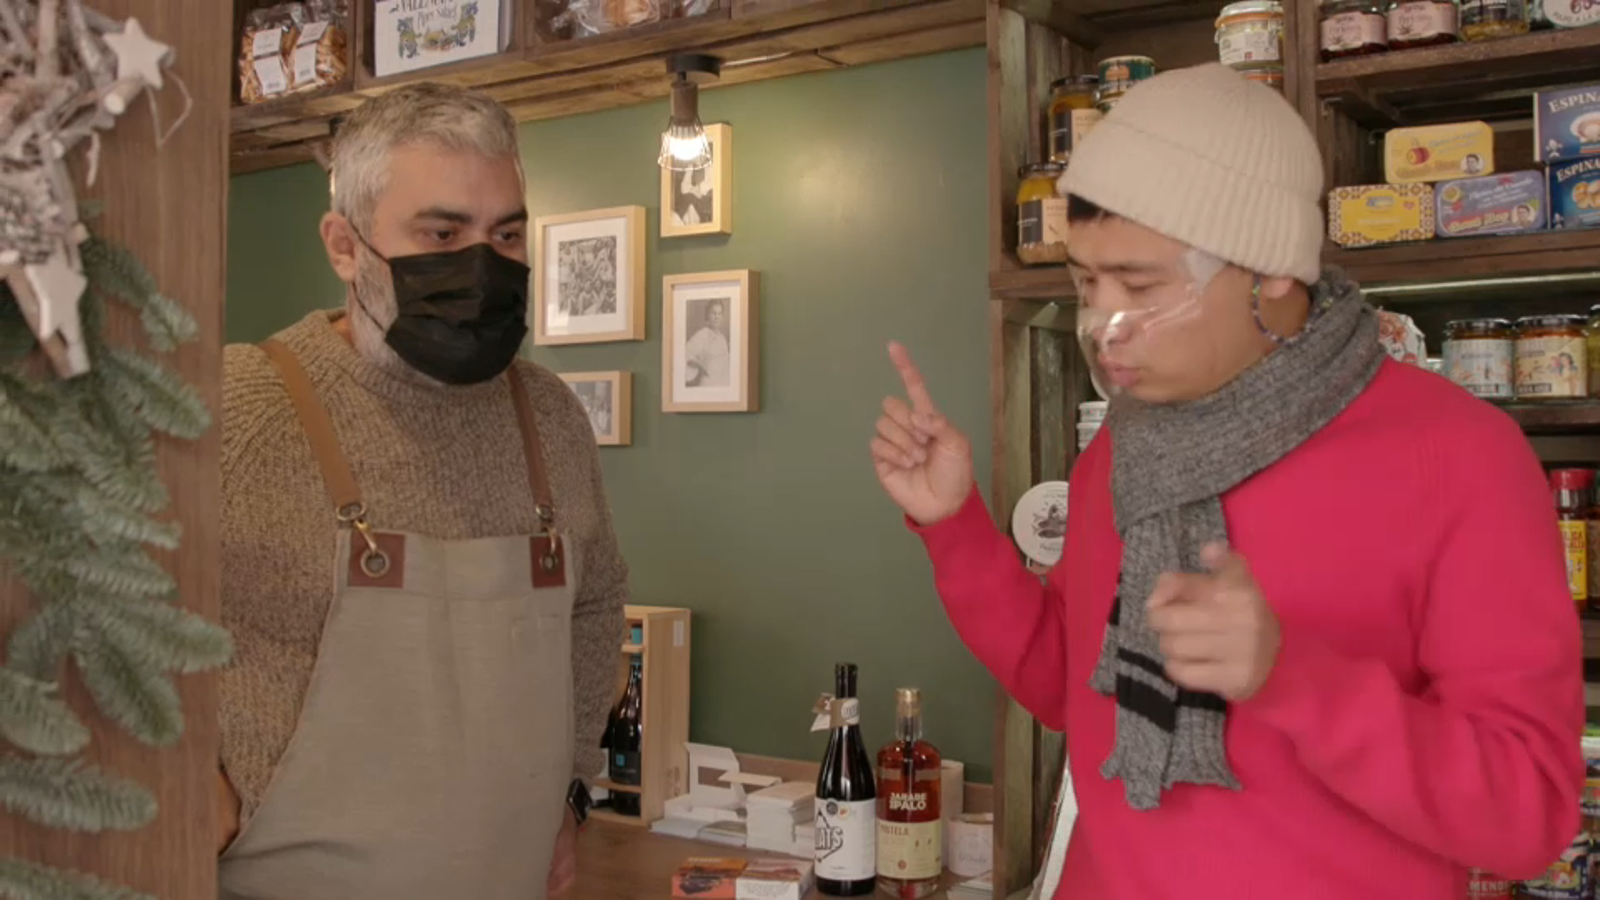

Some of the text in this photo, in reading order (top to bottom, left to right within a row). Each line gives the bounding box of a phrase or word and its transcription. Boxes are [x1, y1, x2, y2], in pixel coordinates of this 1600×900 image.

[1548, 91, 1600, 113] ESPIN
[889, 792, 927, 801] JARABE
[896, 801, 927, 811] PALO
